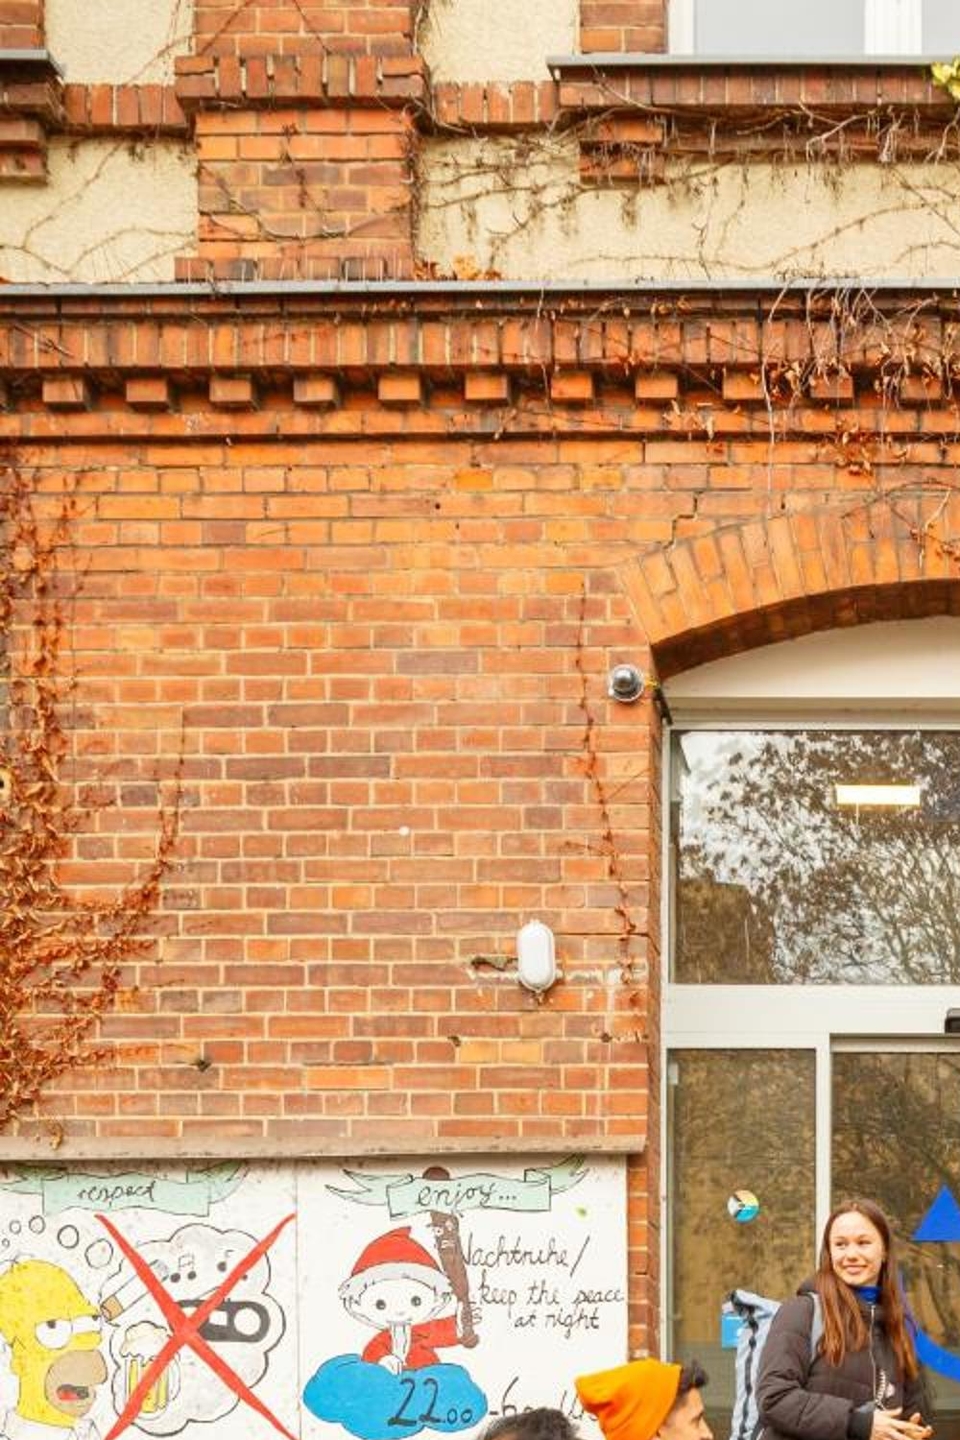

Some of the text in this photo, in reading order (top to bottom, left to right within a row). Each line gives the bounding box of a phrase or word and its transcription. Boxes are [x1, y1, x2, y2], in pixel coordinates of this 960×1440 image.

[78, 1181, 156, 1207] respect
[479, 1270, 517, 1319] keep
[526, 1279, 560, 1305] the
[514, 1313, 537, 1328] at
